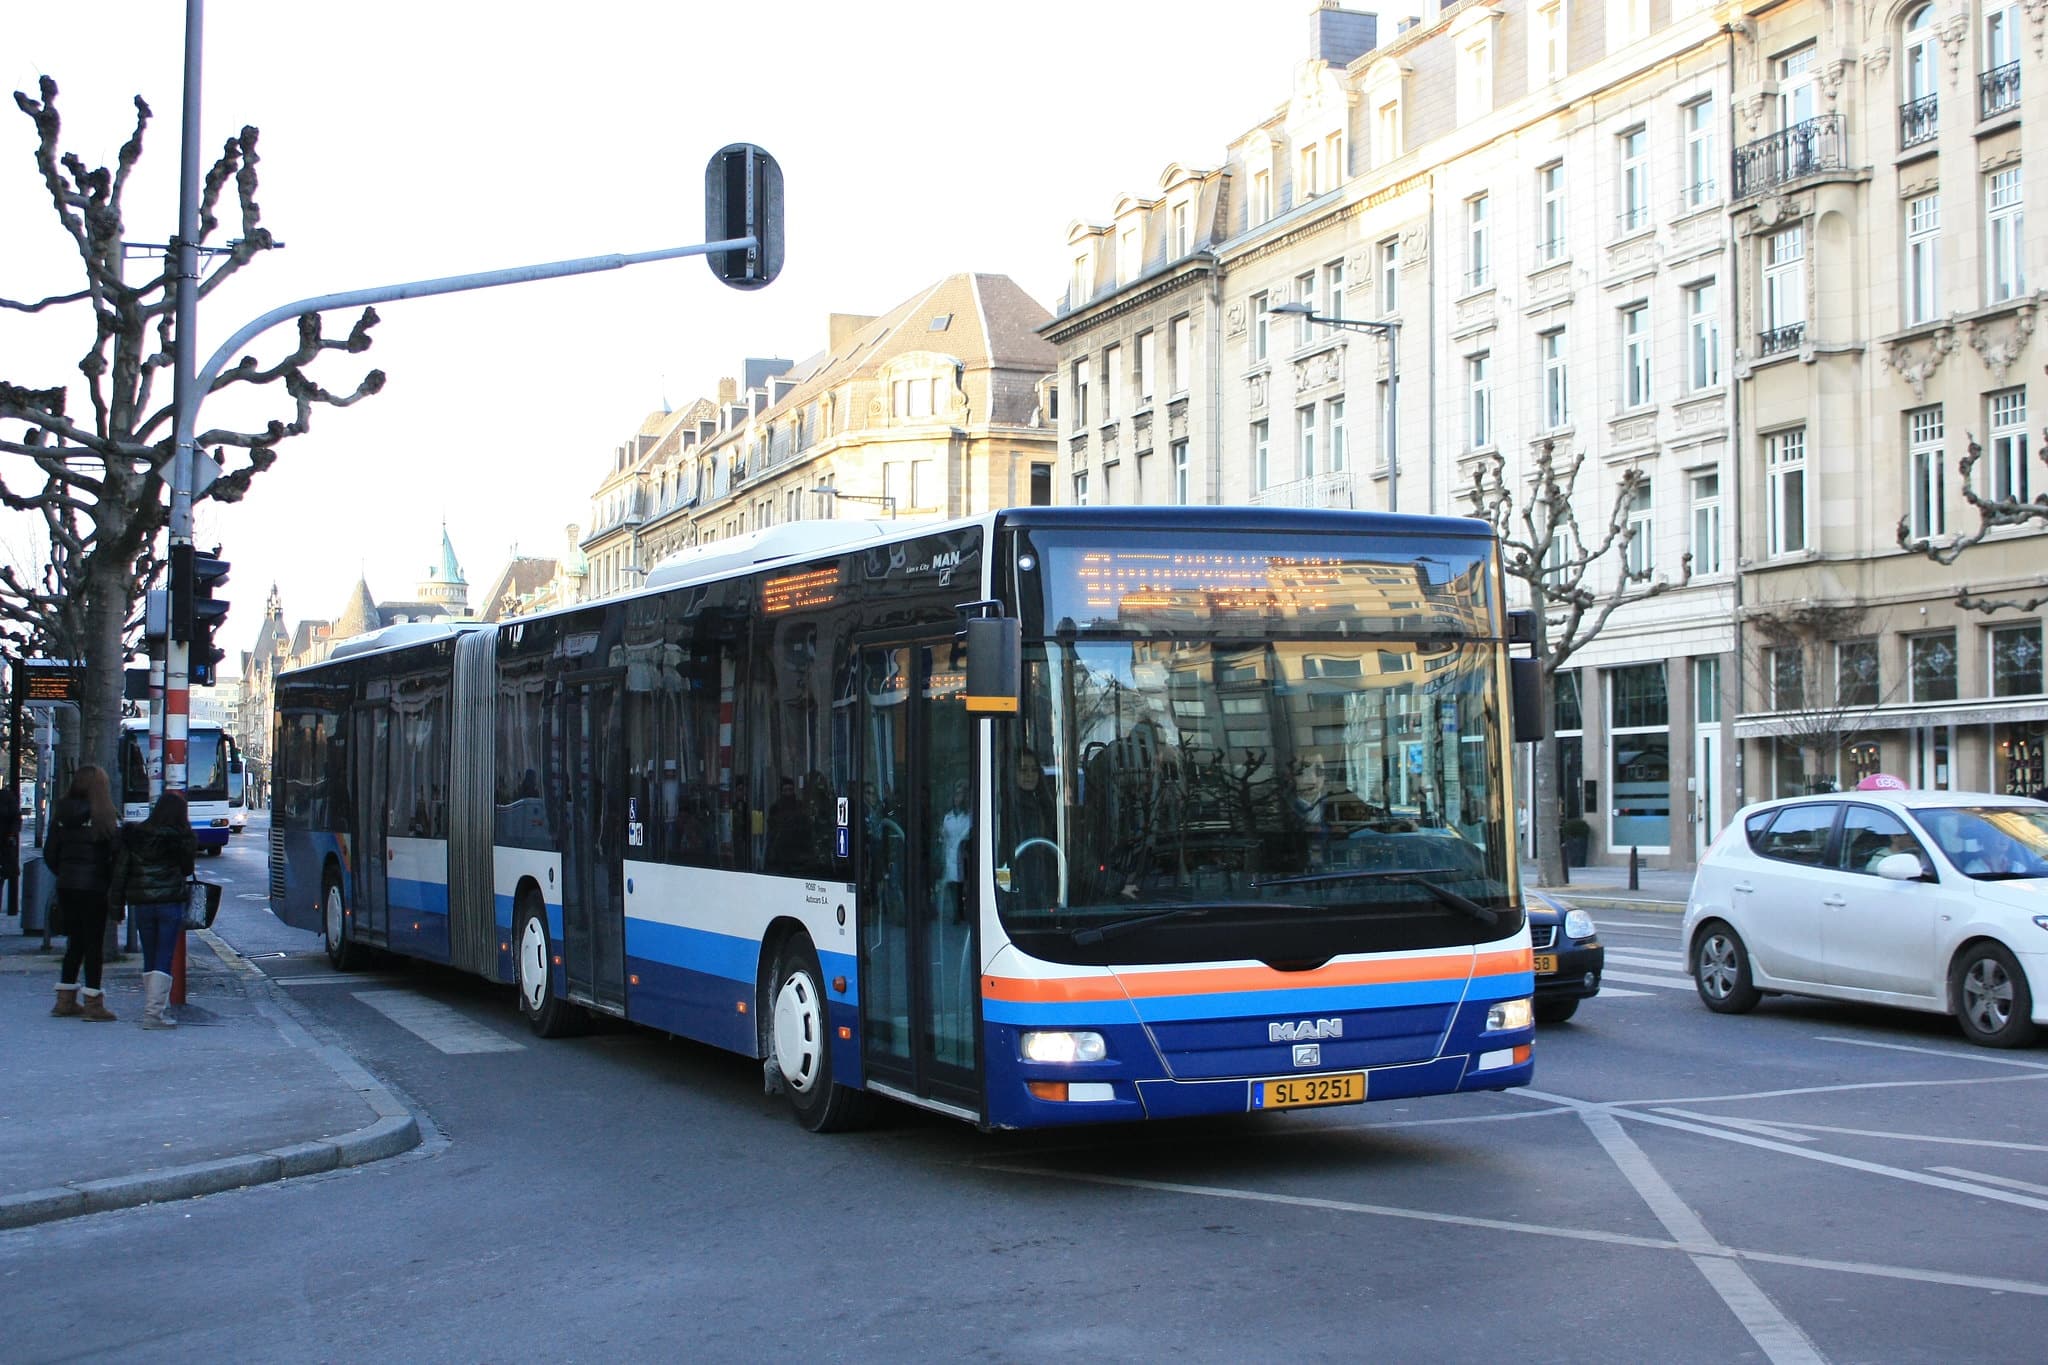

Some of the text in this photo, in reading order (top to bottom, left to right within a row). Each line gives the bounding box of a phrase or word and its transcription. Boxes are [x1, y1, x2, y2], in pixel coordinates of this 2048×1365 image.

[932, 551, 960, 568] MAN
[2005, 783, 2042, 794] PAIN
[1268, 1018, 1343, 1042] MAN
[1255, 1079, 1352, 1105] L SL 3251
